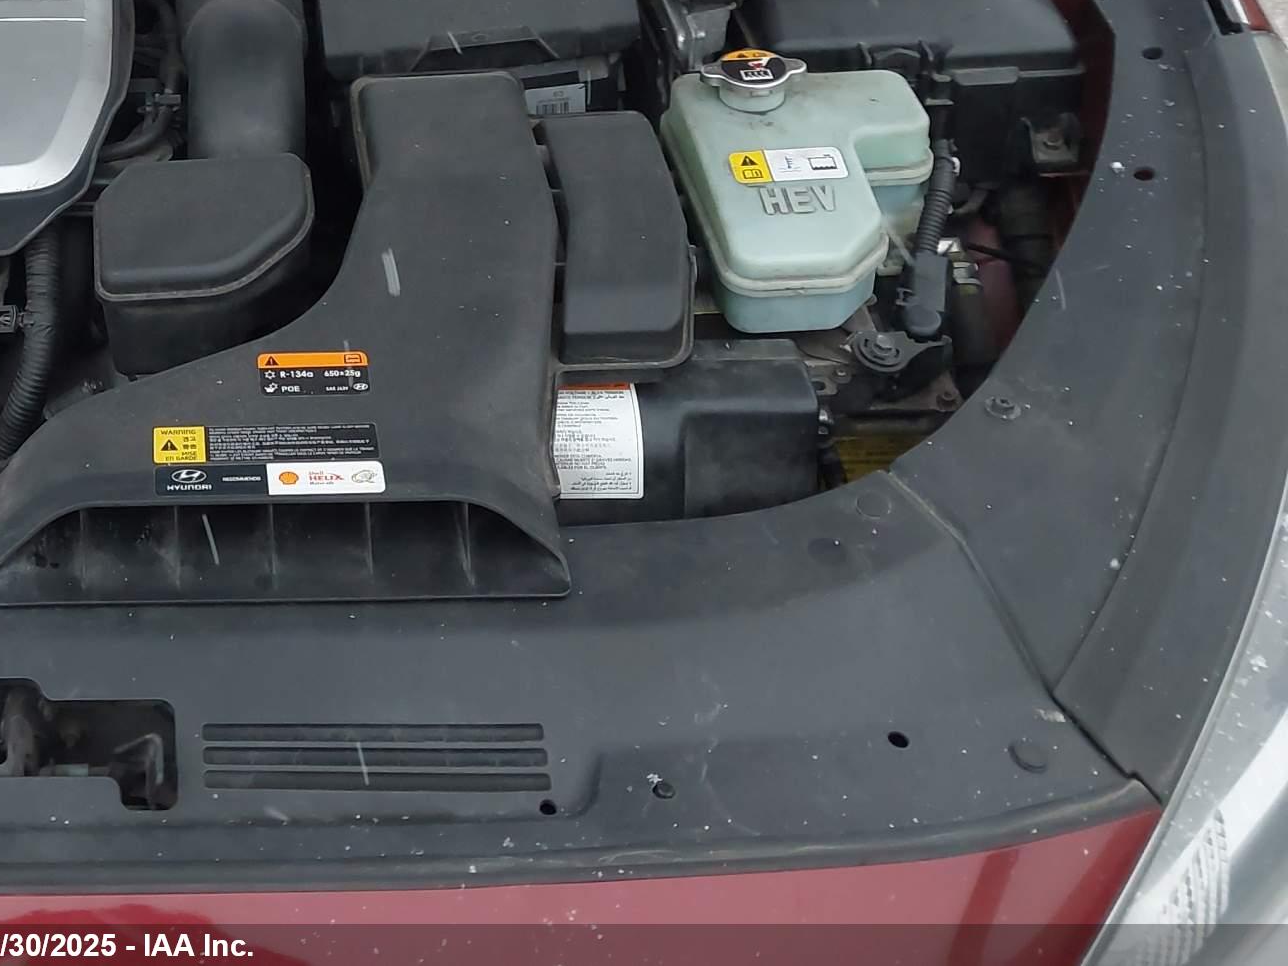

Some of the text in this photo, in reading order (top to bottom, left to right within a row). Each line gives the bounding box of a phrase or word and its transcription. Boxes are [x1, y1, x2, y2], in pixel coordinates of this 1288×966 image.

[759, 185, 837, 216] HEV
[279, 369, 314, 378] R-134a
[281, 385, 301, 393] POE
